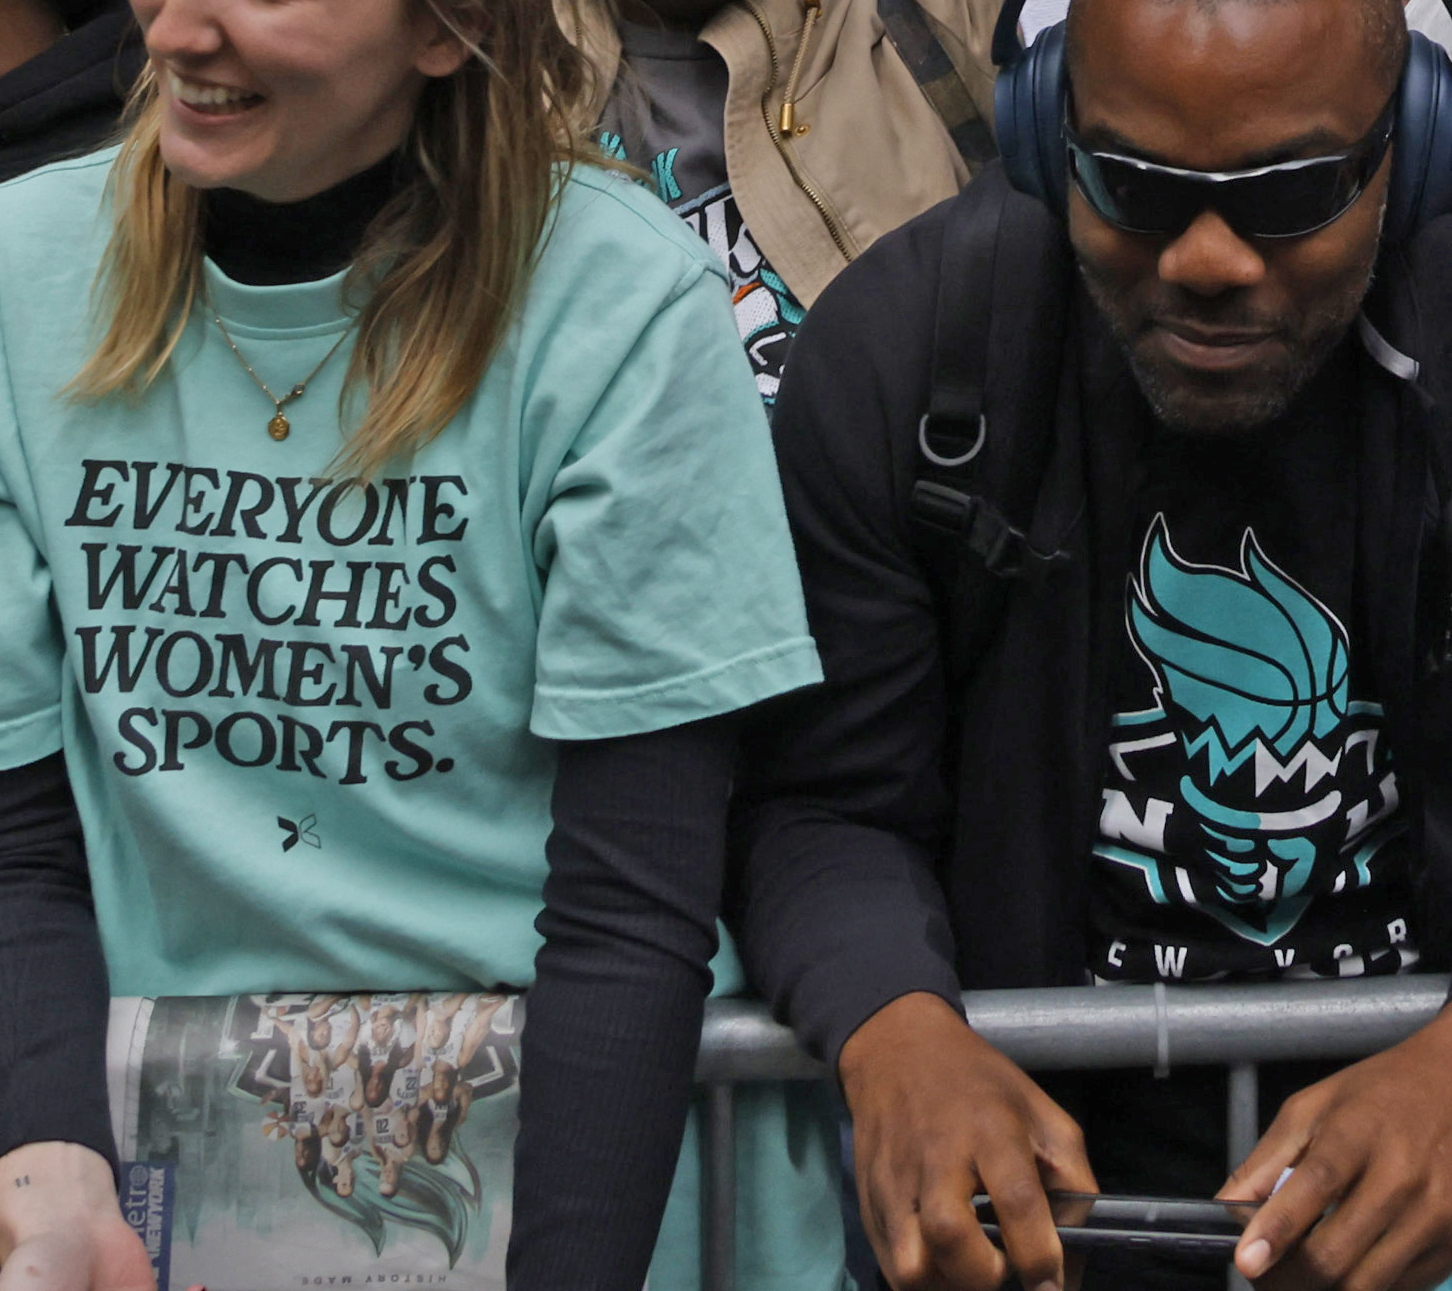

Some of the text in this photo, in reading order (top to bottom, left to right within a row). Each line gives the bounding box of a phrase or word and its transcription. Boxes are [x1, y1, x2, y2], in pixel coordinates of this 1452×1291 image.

[64, 458, 469, 547] EVERYONE
[80, 542, 457, 631] WATCHES
[75, 624, 473, 710] WOMEN'S
[112, 707, 456, 786] SPORTS.
[125, 1165, 148, 1243] etro
[365, 1273, 447, 1284] HISTORY
